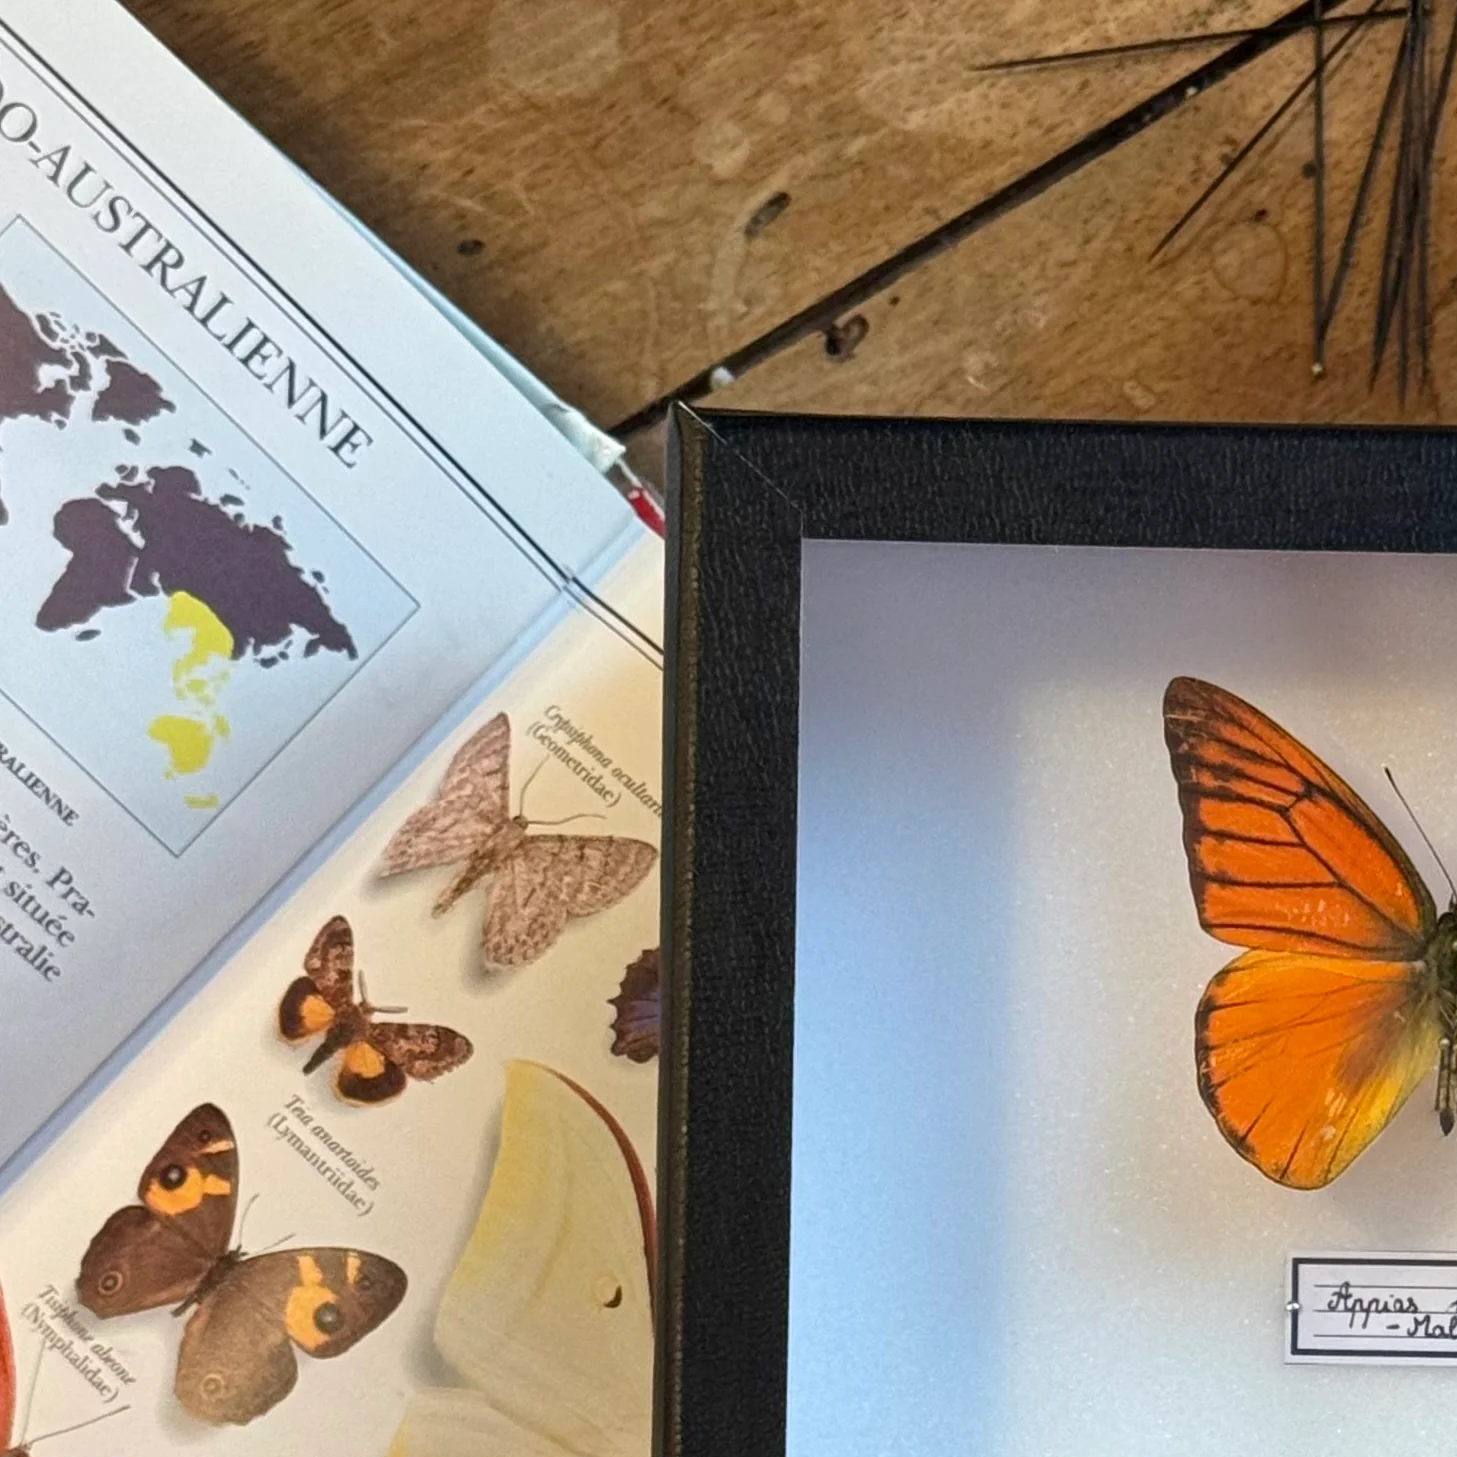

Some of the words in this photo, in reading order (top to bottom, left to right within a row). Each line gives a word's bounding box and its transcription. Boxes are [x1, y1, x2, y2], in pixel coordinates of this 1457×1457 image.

[0, 80, 374, 469] O-AUSTRALIENNE
[525, 721, 621, 808] (Geometridae)
[4, 881, 75, 948] située
[45, 866, 95, 918] Pra-
[0, 916, 61, 982] tralie
[283, 1094, 315, 1126] Teia
[265, 1112, 374, 1217] (Lymantriidae)
[1327, 1281, 1419, 1329] Appias
[21, 1303, 119, 1404] (Nymphalidae)
